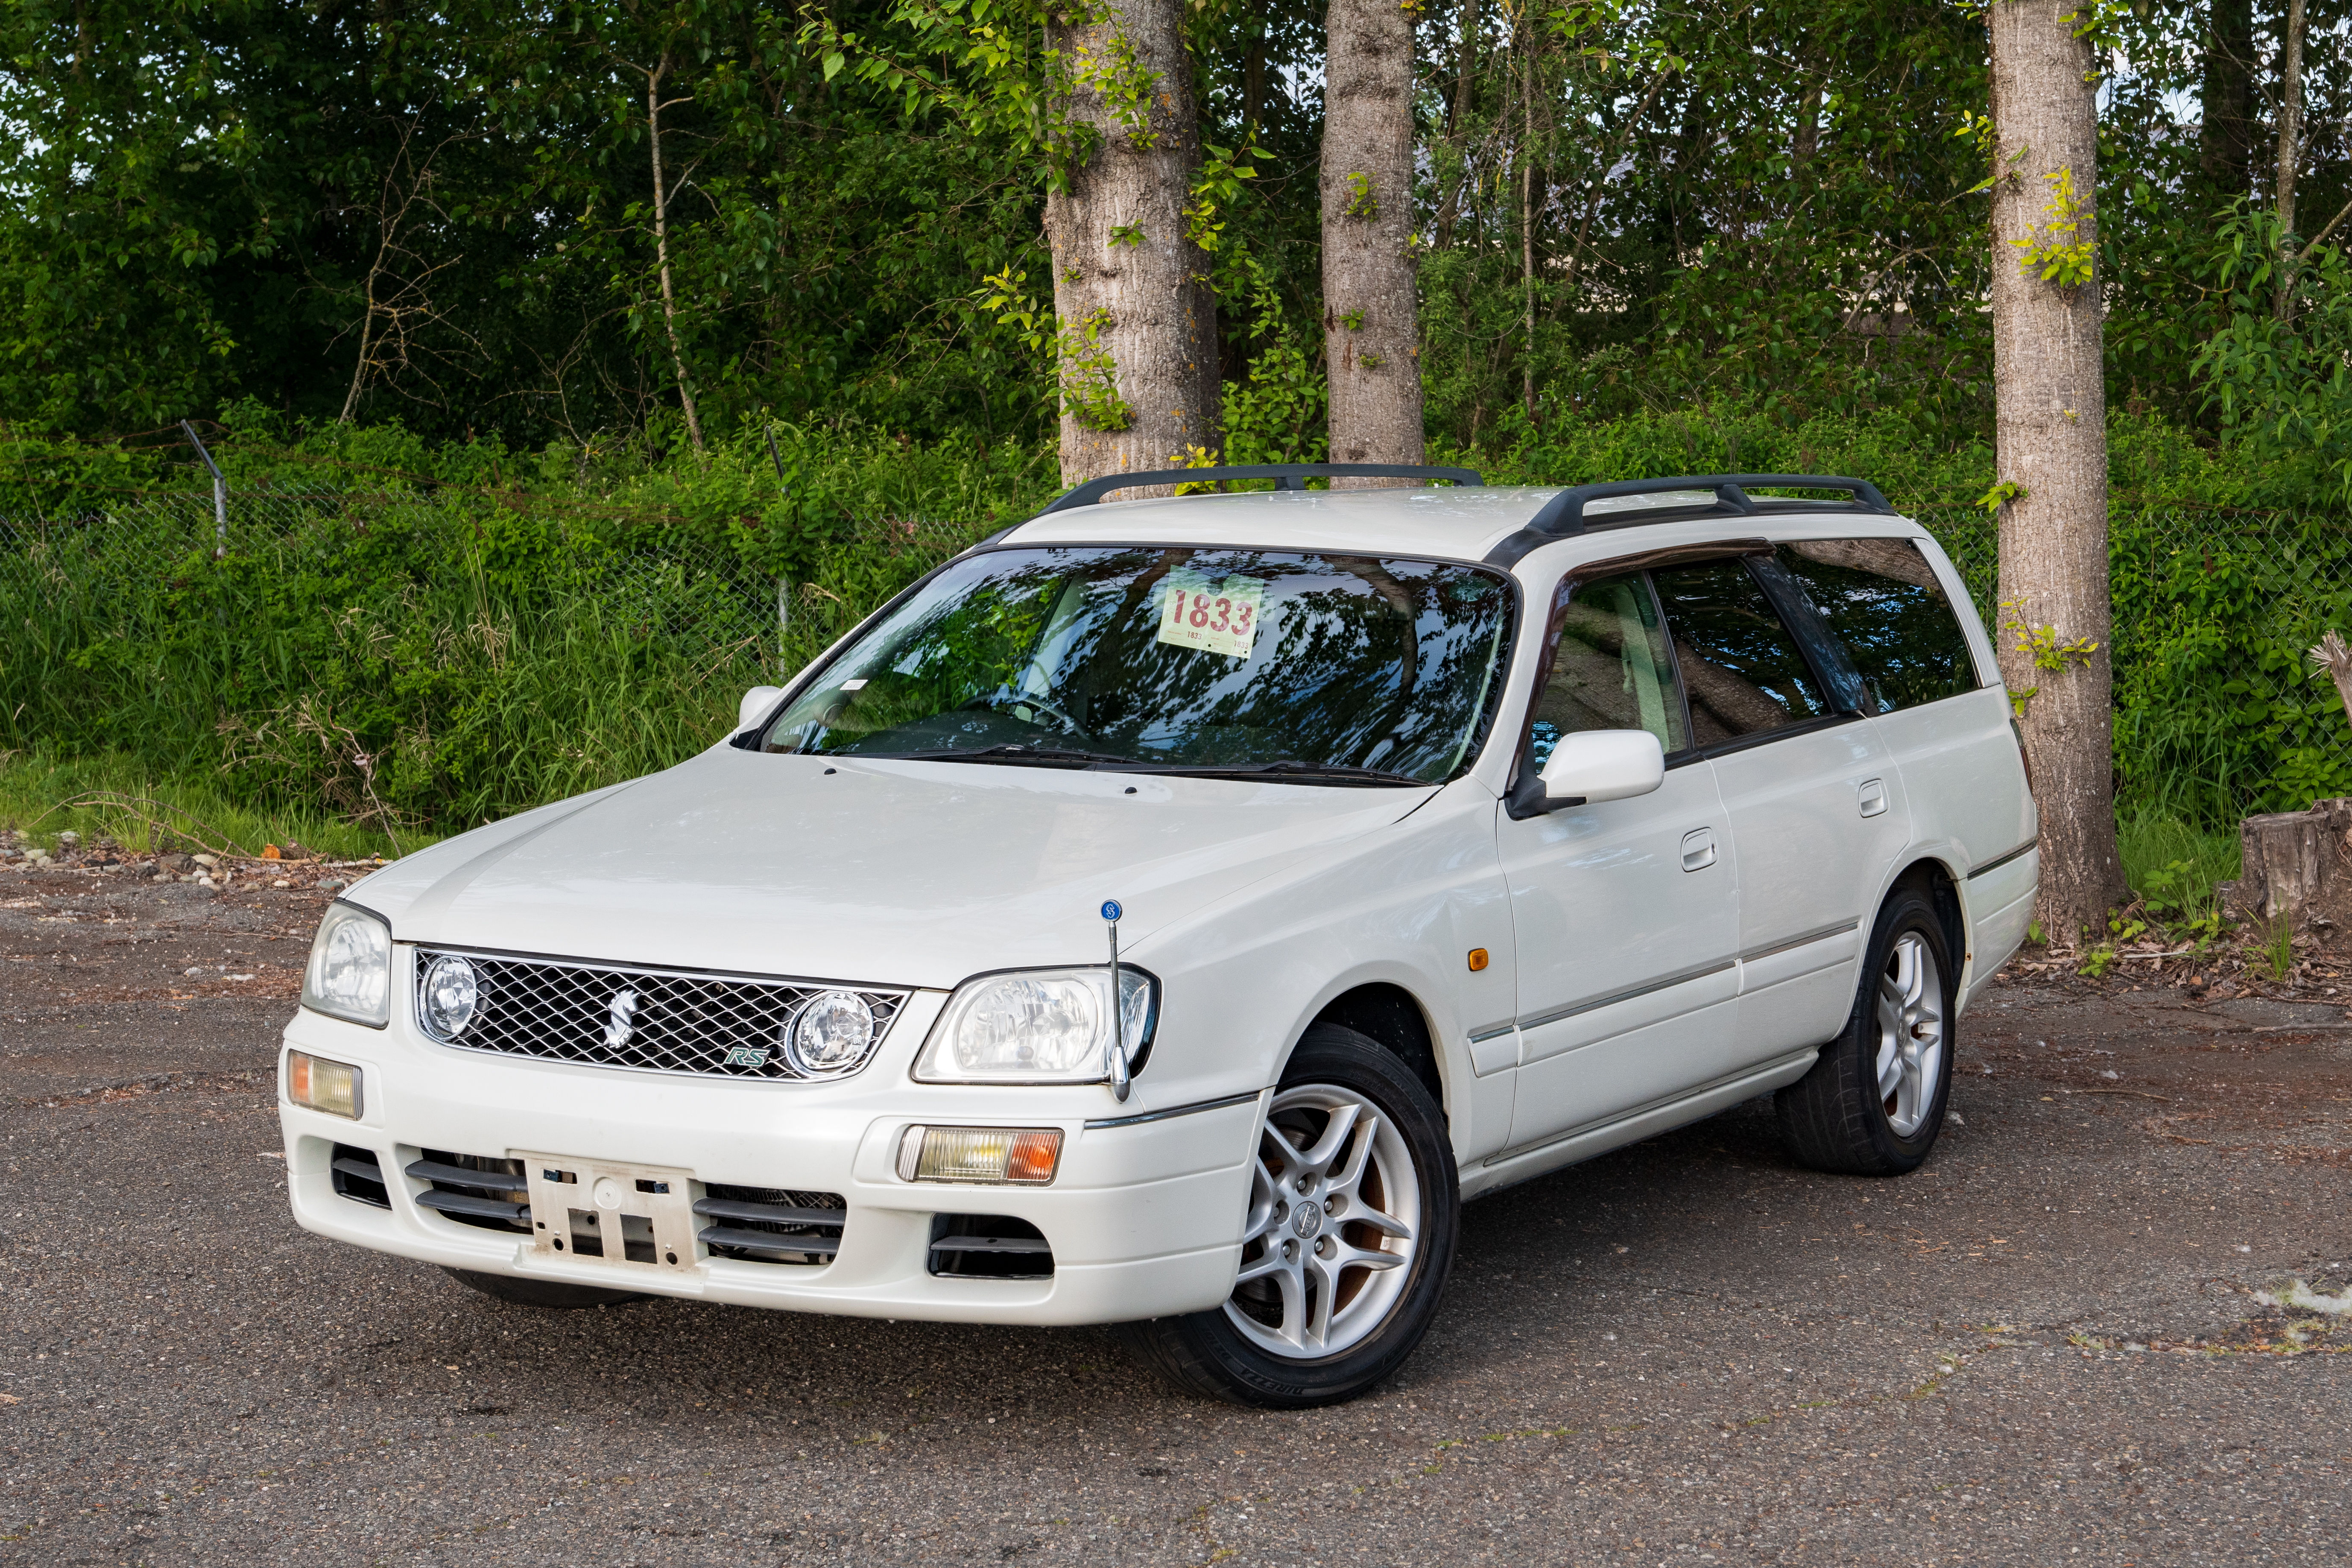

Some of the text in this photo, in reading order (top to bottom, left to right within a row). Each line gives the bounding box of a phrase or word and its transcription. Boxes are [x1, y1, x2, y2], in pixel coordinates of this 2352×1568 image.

[1174, 589, 1252, 635] 1833
[1188, 631, 1202, 640] 1833
[1234, 641, 1249, 649] 1833
[724, 1047, 770, 1067] RS
[1240, 1368, 1305, 1395] DIREZZA
